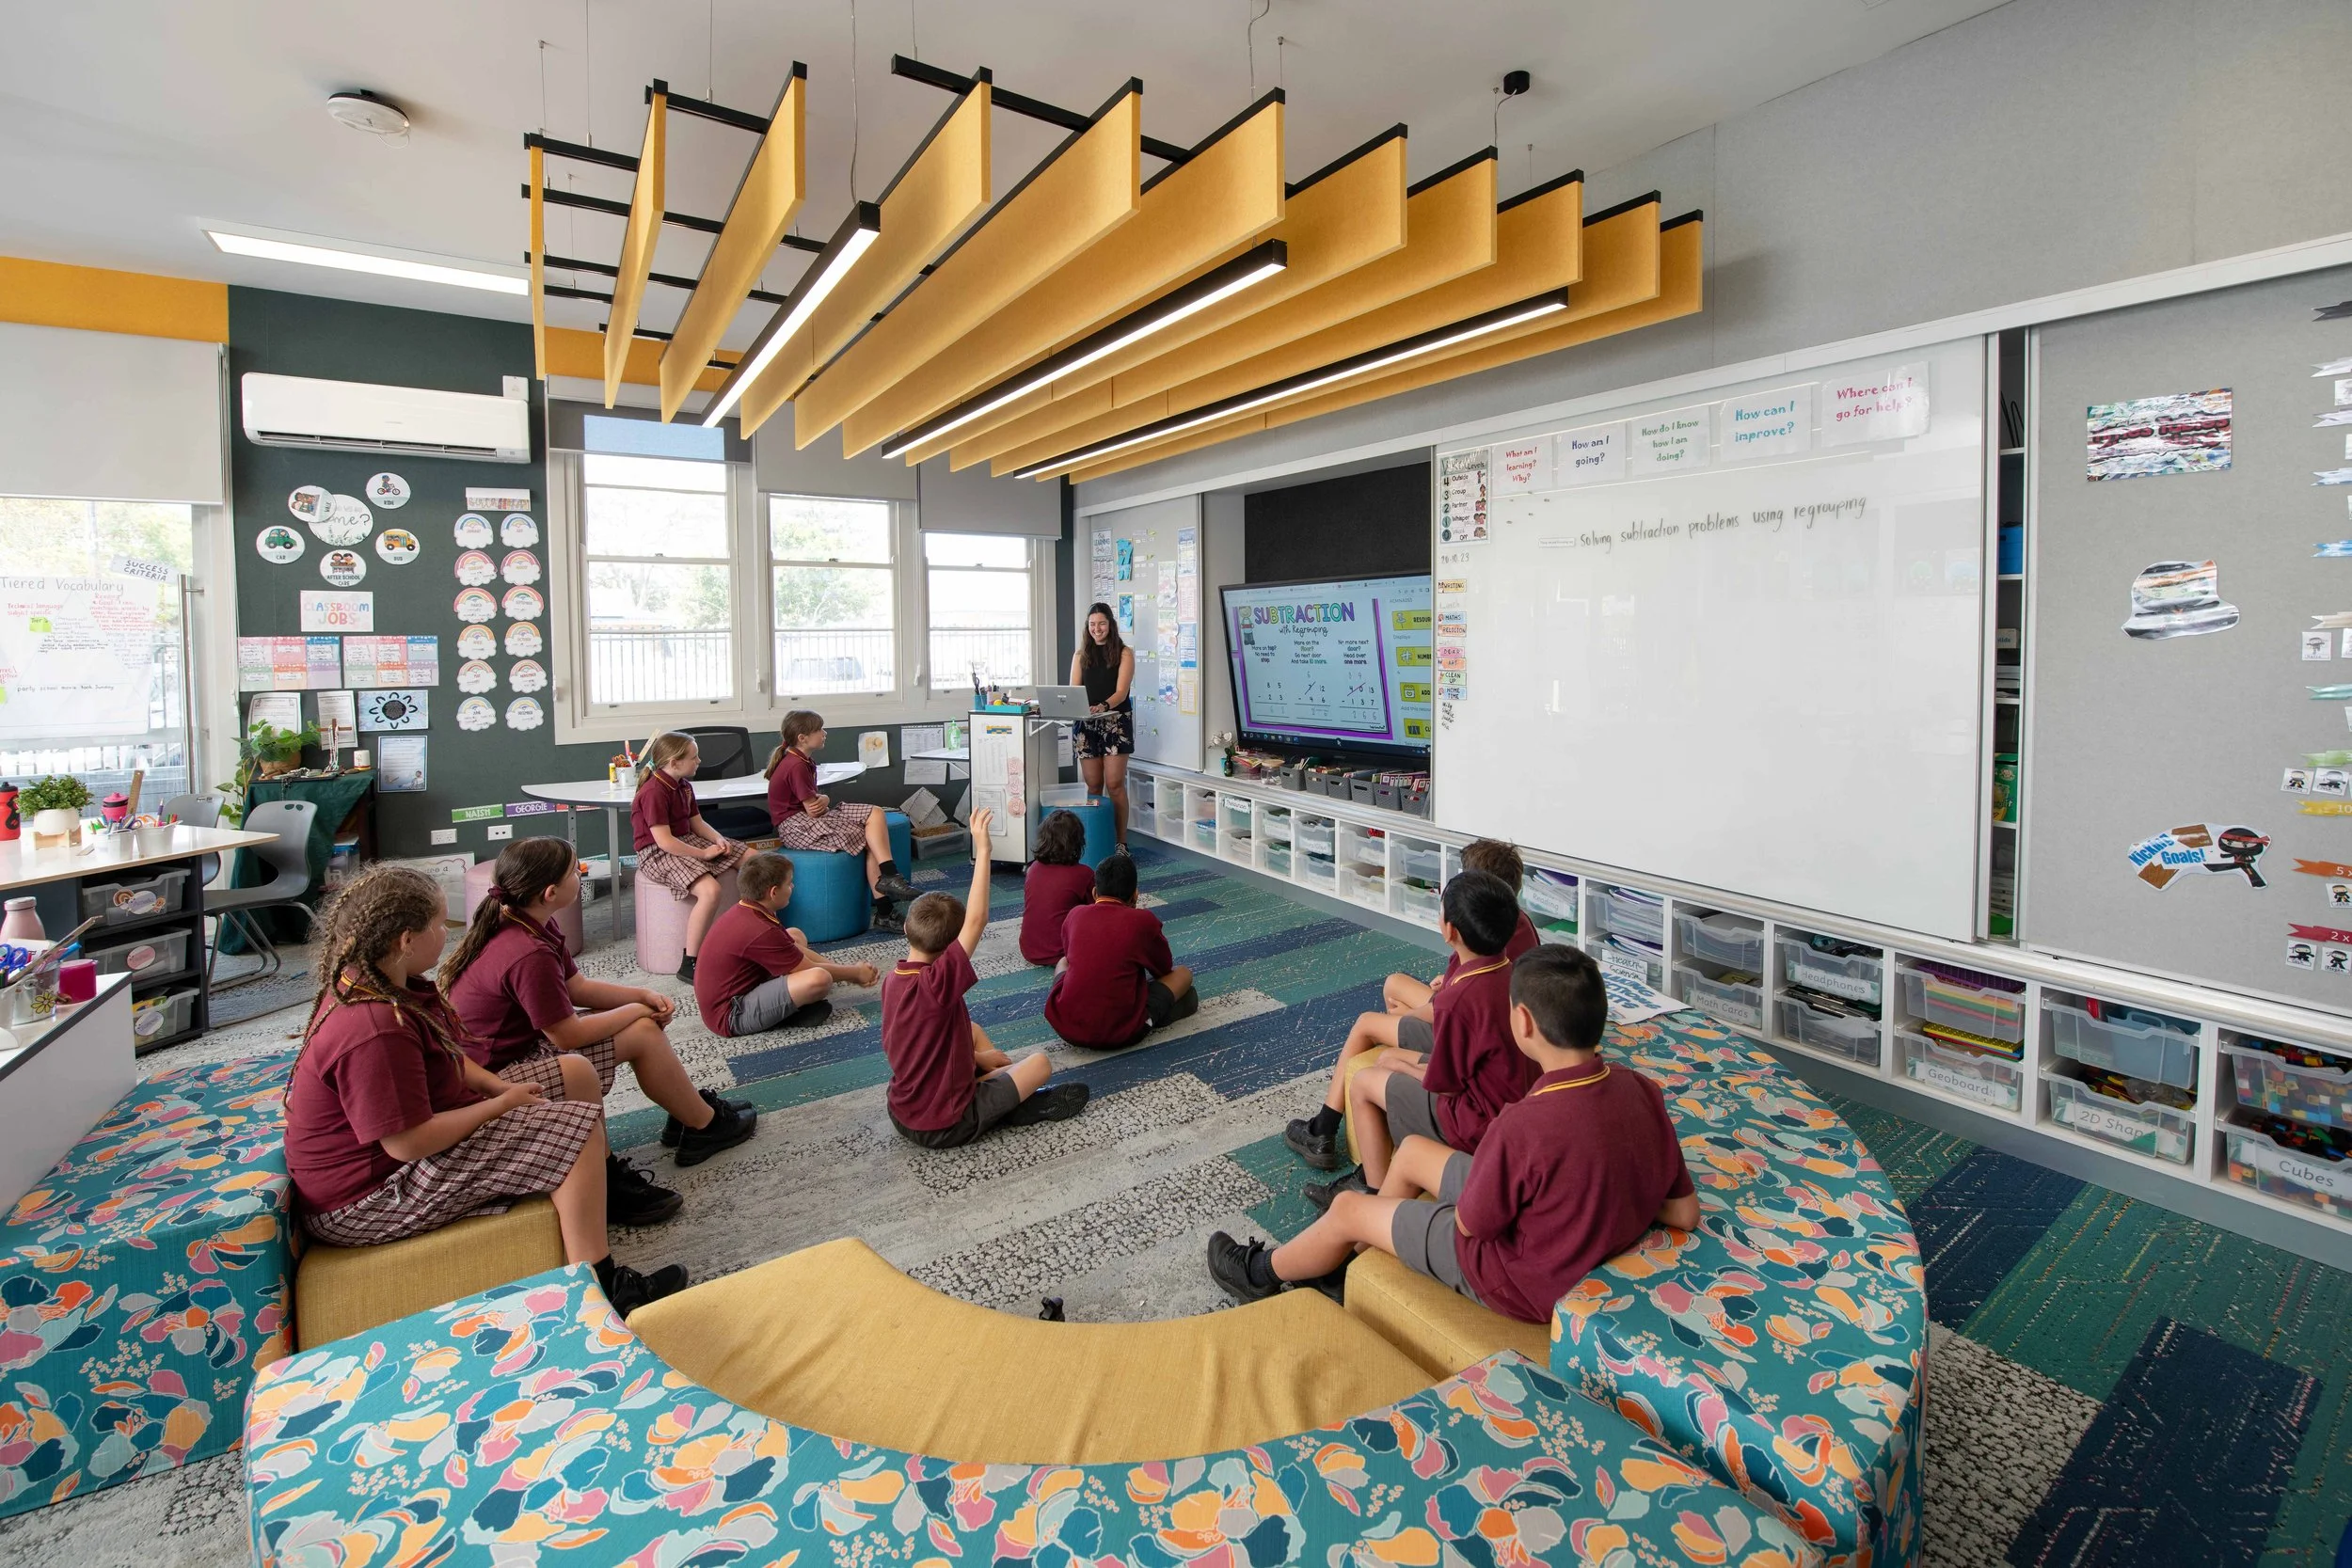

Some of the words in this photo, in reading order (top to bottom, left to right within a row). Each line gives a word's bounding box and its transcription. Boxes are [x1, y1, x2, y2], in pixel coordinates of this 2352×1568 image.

[1836, 387, 1879, 400] Where
[1882, 381, 1903, 392] can
[1735, 408, 1760, 421] How
[1764, 406, 1786, 417] can
[1790, 401, 1794, 412] I
[1836, 410, 1851, 421] go
[1853, 405, 1872, 418] for
[1875, 396, 1913, 412] help?
[1642, 428, 1658, 436] How
[1660, 424, 1670, 433] do
[1672, 422, 1676, 431] I
[1677, 420, 1699, 429] know
[1735, 421, 1794, 443] improve?
[1571, 440, 1589, 450] How
[1606, 436, 1609, 445] I
[1653, 439, 1669, 449] how
[1670, 437, 1674, 446] I
[1506, 449, 1522, 458] What
[1576, 452, 1605, 467] going?
[1656, 450, 1685, 462] doing?
[1468, 462, 1485, 470] Levels
[1506, 459, 1536, 471] learning?
[1443, 477, 1449, 486] 4
[1513, 473, 1532, 483] Why?
[1444, 490, 1449, 499] 3
[1444, 504, 1449, 513] 2
[1581, 533, 1612, 555] Solving
[1621, 517, 1680, 542] subtraction
[1688, 514, 1740, 539] problems
[1753, 510, 1784, 532] using
[1793, 496, 1867, 530] regrouping
[123, 567, 167, 582] CRITERIA
[126, 560, 169, 575] SUCCESS
[0, 577, 45, 590] Tiered
[56, 578, 124, 596] Vocabulary
[37, 603, 64, 611] language
[305, 602, 370, 612] CLASSROOM
[1253, 602, 1356, 625] SUBTRACTION
[318, 612, 357, 625] JOBS
[1279, 625, 1291, 635] with
[1292, 625, 1329, 637] Regrouping
[465, 808, 491, 818] NAISH
[516, 802, 548, 813] GEORGIE
[2337, 804, 2352, 813] 10
[2160, 847, 2206, 865] Goals!
[2336, 866, 2344, 875] 5
[1532, 893, 1559, 914] Reading
[2331, 931, 2339, 940] 2
[1610, 965, 1639, 979] Science
[1802, 970, 1867, 994] Headphones
[1696, 994, 1719, 1010] Math
[1722, 1004, 1749, 1019] Cards
[2079, 1111, 2101, 1124] 2D
[2106, 1118, 2143, 1138] Shap
[2280, 1160, 2334, 1187] Cubes
